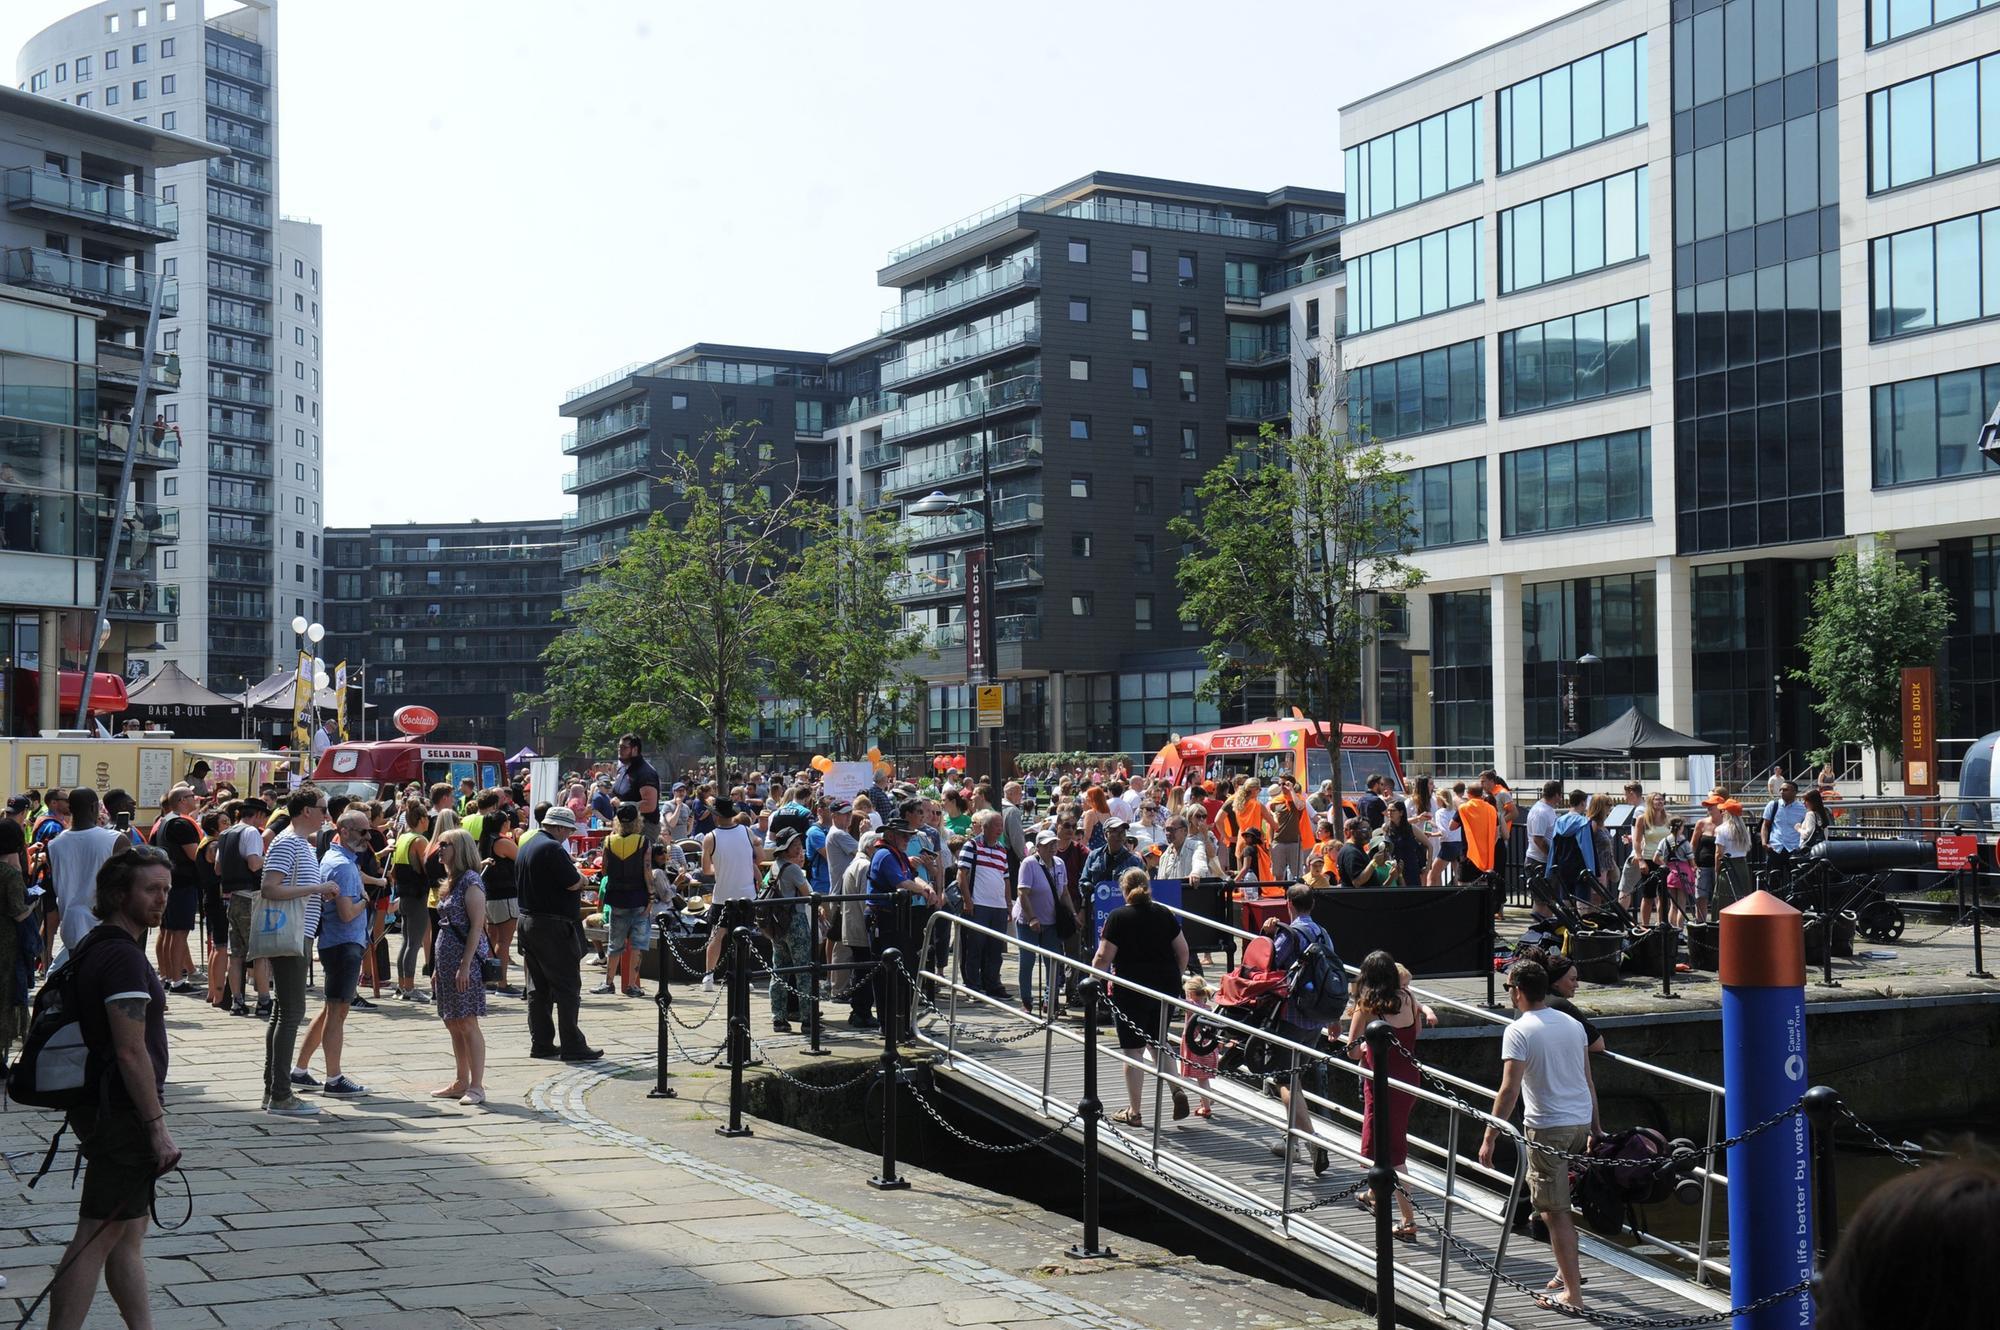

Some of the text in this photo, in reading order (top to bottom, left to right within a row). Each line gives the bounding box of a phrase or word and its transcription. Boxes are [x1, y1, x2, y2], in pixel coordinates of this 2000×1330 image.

[972, 563, 980, 604] DOCK
[972, 608, 981, 658] LEEDS
[148, 705, 206, 716] BAR-B-QUE
[400, 713, 435, 726] Cocktails
[1912, 683, 1922, 749] LEEDS DOCK
[1223, 736, 1259, 748] ICE CREAM
[1342, 736, 1368, 745] CREAM
[427, 750, 472, 759] SELA BAR
[1937, 847, 1959, 855] Danger
[1794, 1112, 1804, 1155] water
[1795, 1159, 1806, 1180] by
[1796, 1185, 1807, 1235] better
[1797, 1239, 1808, 1264] life
